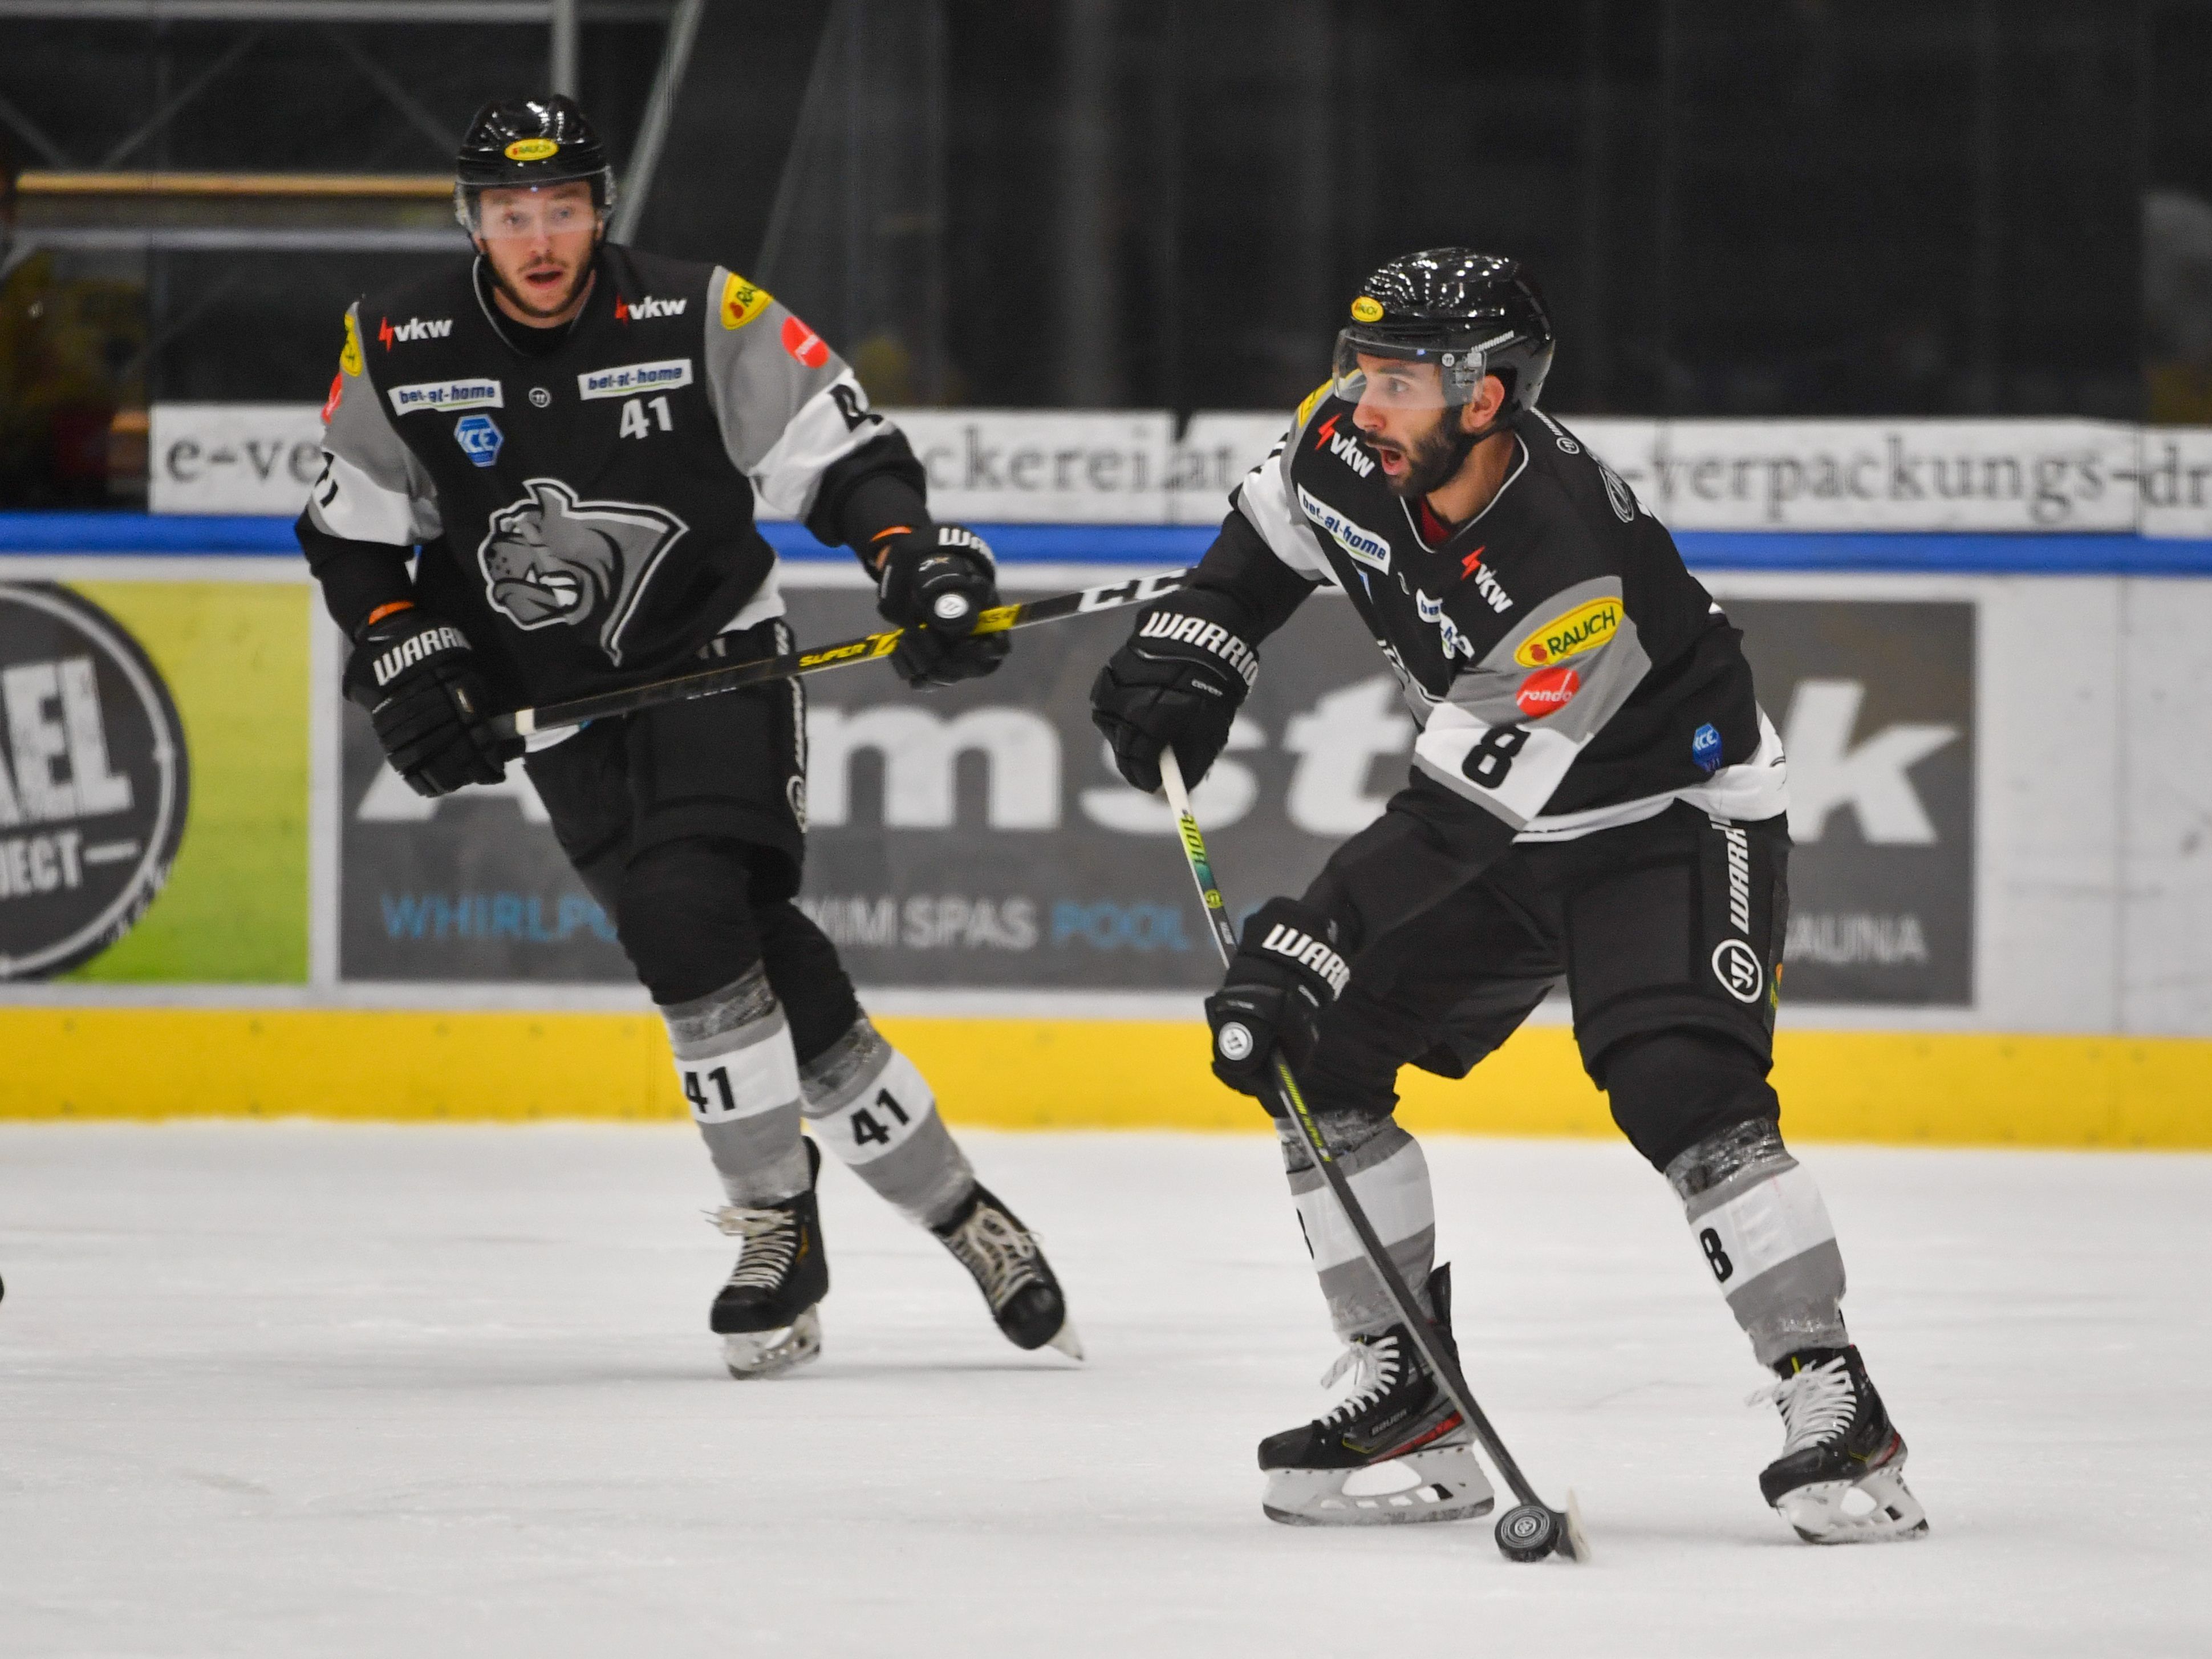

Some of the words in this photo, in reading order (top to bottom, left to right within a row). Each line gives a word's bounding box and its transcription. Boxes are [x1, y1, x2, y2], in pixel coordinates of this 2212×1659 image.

[393, 318, 453, 342] vkw
[628, 296, 687, 319] vkw
[619, 396, 673, 439] 41
[1329, 432, 1375, 478] vkw
[1302, 494, 1387, 560] bet-at-home
[1475, 563, 1513, 614] vkw
[1139, 610, 1259, 695] WARRIO
[1547, 606, 1617, 656] RAUCH
[1462, 724, 1532, 790] 8
[1695, 729, 1717, 751] ICE
[904, 894, 1036, 951] SPAS
[684, 1066, 736, 1114] 41
[850, 1088, 910, 1146] 41
[1699, 1227, 1734, 1283] 8
